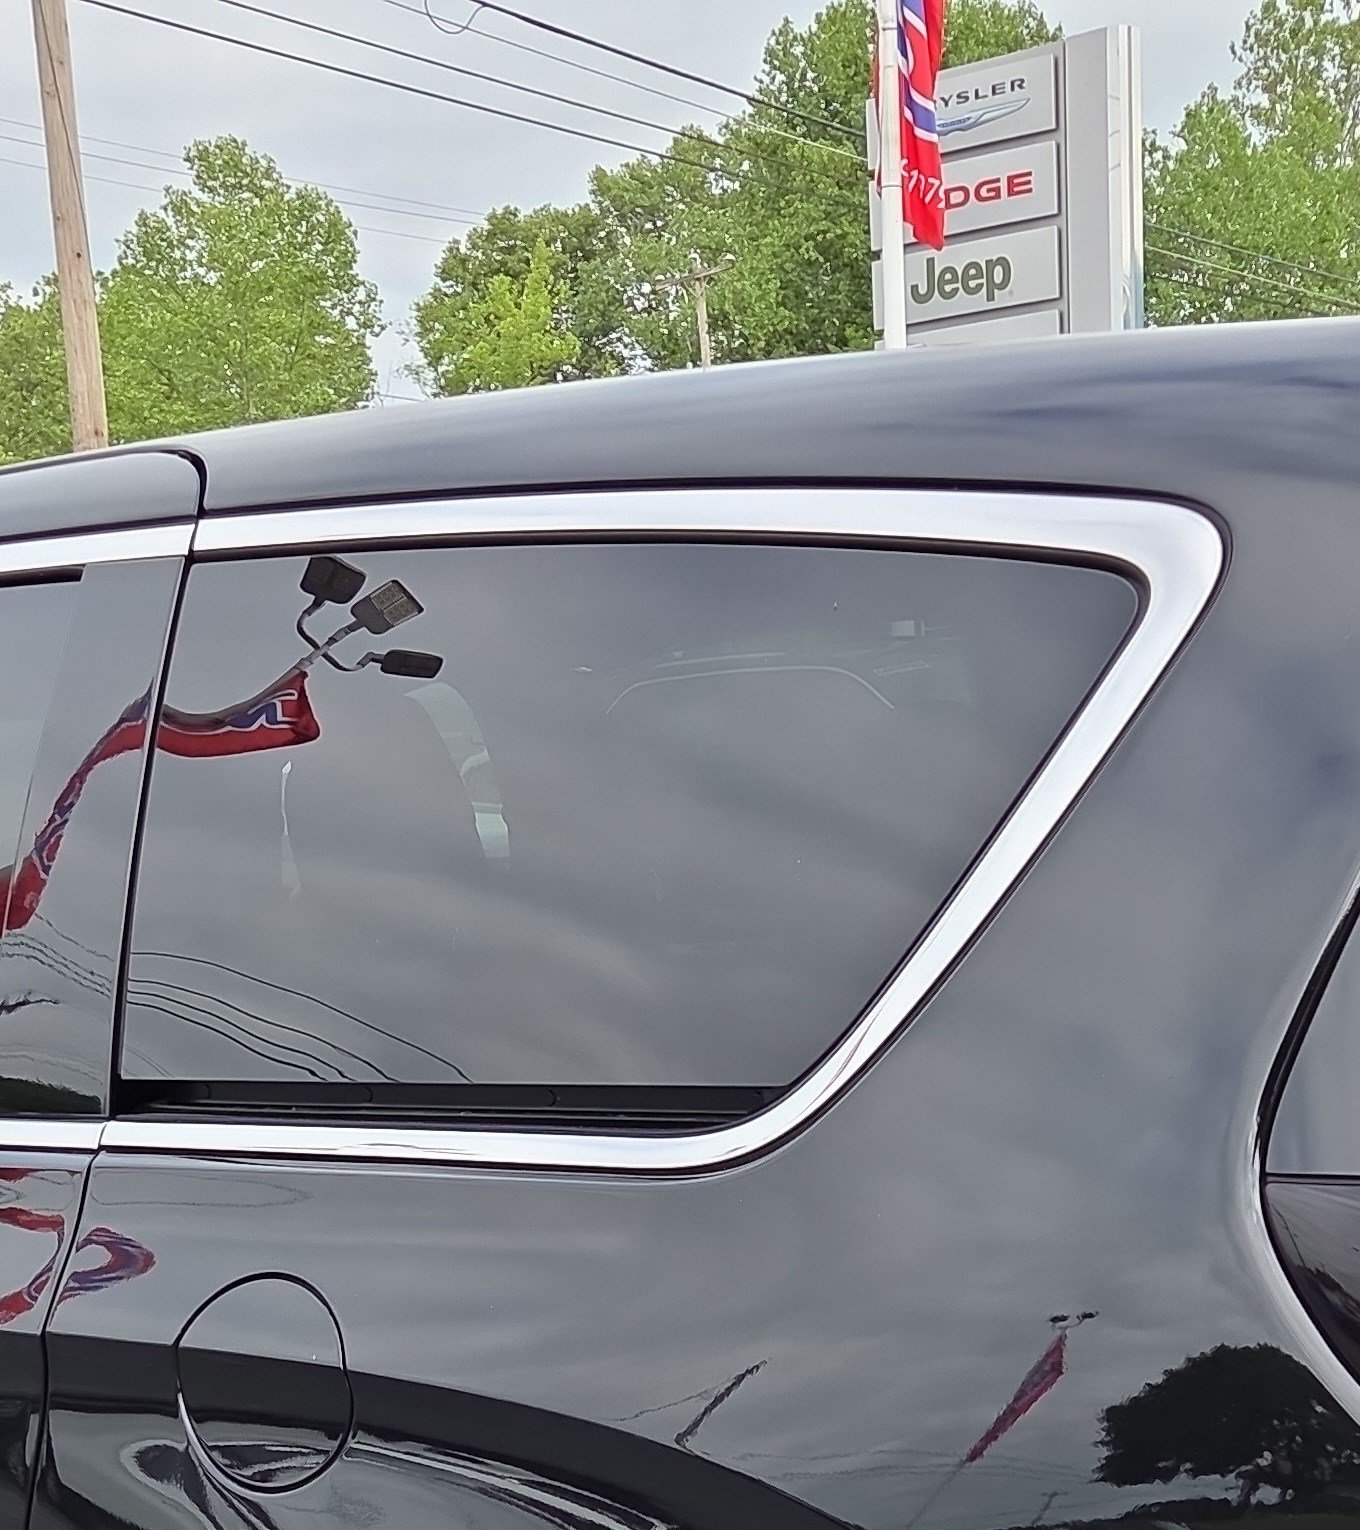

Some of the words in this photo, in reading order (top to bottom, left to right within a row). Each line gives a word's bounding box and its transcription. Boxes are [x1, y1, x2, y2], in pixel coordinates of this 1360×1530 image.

[935, 77, 1027, 110] YSLER
[943, 171, 1033, 210] DGE
[910, 255, 1012, 304] Jeep
